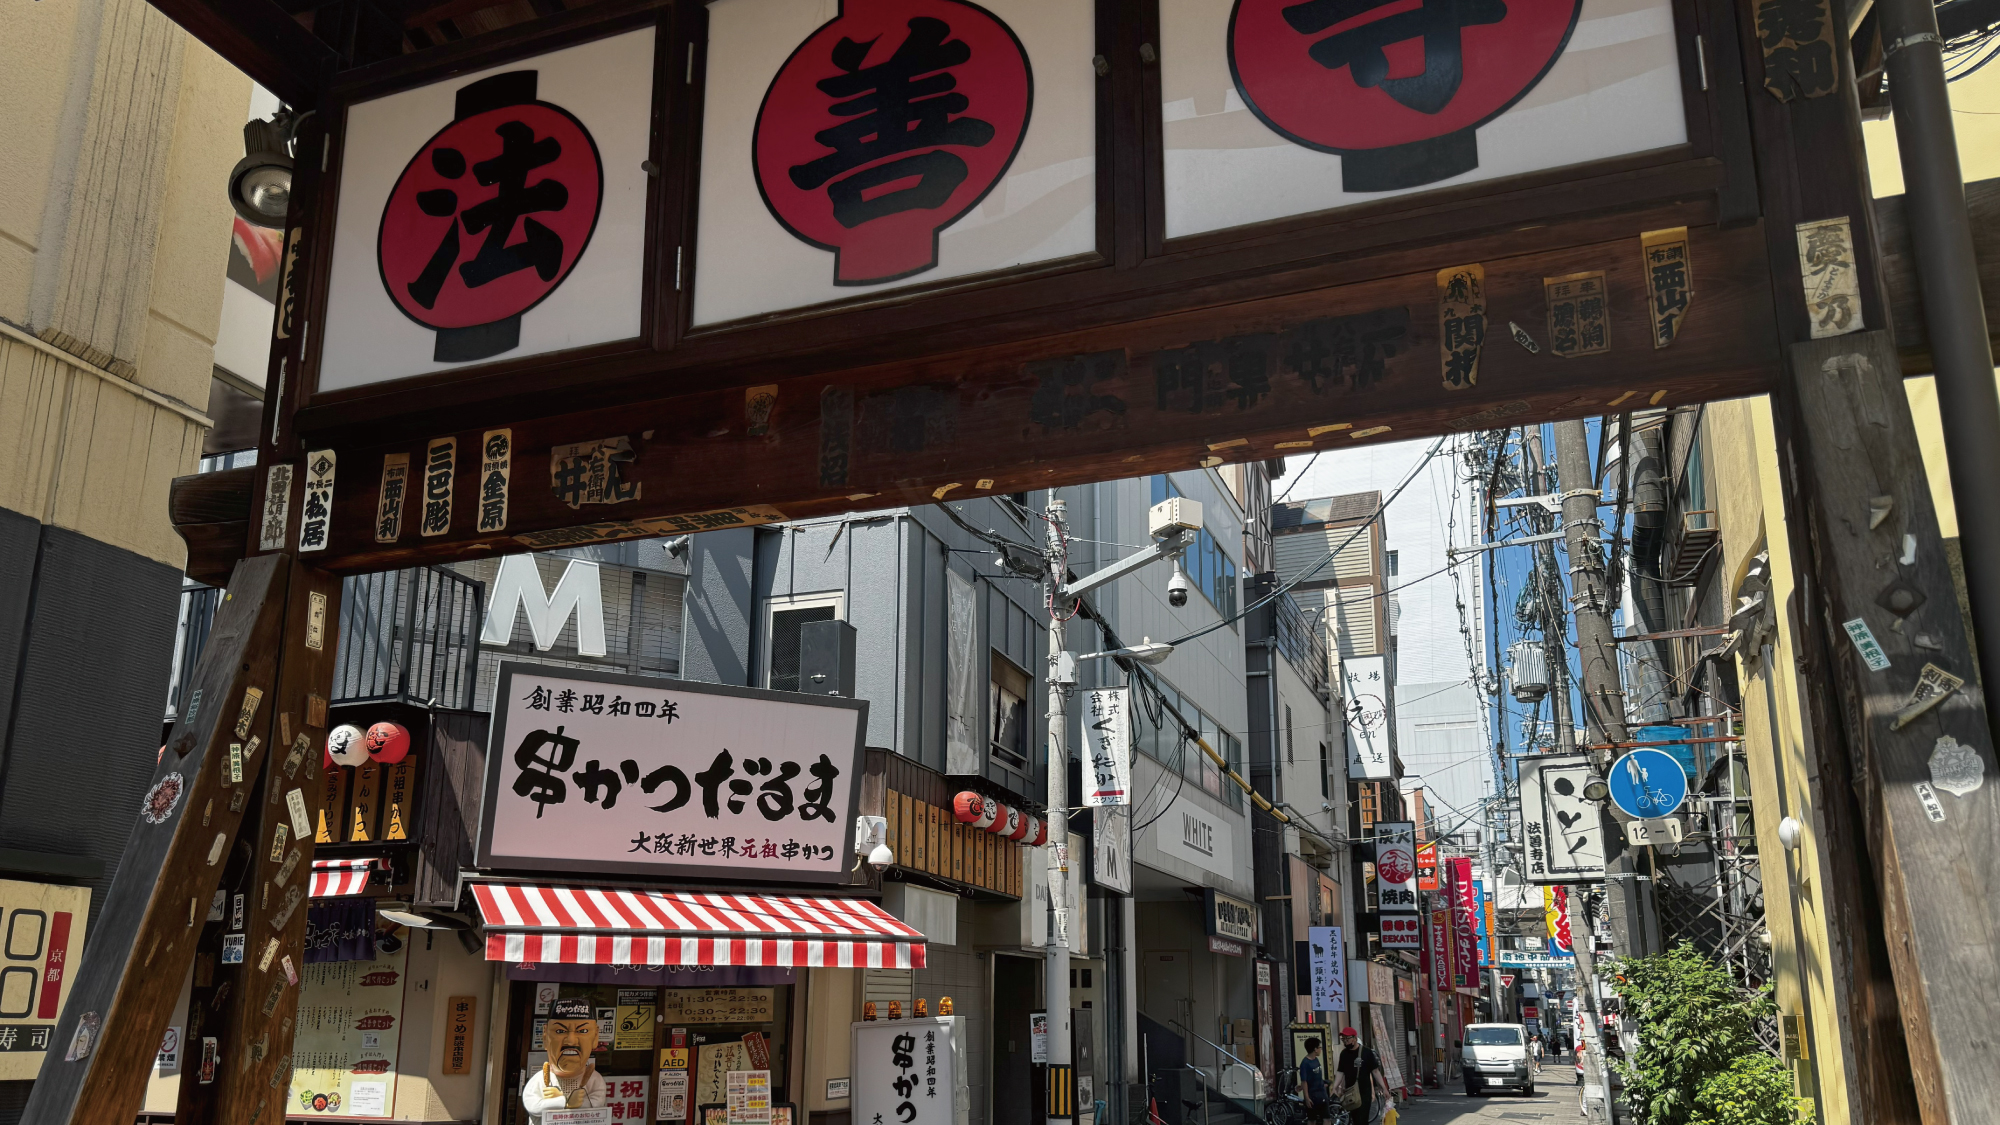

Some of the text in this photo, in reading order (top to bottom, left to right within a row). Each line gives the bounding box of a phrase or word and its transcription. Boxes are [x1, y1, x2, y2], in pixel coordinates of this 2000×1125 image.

[407, 121, 569, 309] 法
[788, 19, 995, 229] 善
[481, 553, 607, 657] M
[1348, 671, 1381, 683] 牧場
[523, 685, 680, 724] 創業昭和四年
[512, 726, 840, 823] 串かつだるま
[1353, 752, 1385, 765] 直送
[390, 761, 406, 833] 元祖串かつ
[628, 831, 834, 860] 大阪新世界元祖串かつ
[1183, 812, 1213, 852] WHITE
[1378, 828, 1411, 845] 炭火
[1526, 822, 1544, 874] 法善寺店
[1106, 845, 1117, 880] M
[1382, 889, 1414, 905] 焼肉
[1455, 881, 1472, 937] DAISO
[1382, 935, 1419, 943] EEKATEI
[1460, 938, 1471, 972] ダイソー
[47, 949, 63, 982] 京都
[1314, 961, 1324, 984] 一頭牛
[1331, 960, 1338, 975] 焼肉
[1329, 977, 1342, 1003] 八六
[0, 1027, 50, 1050] 寿司
[663, 1059, 685, 1067] AED
[892, 1032, 918, 1123] 串かつ
[924, 1031, 936, 1098] 創業昭和四年
